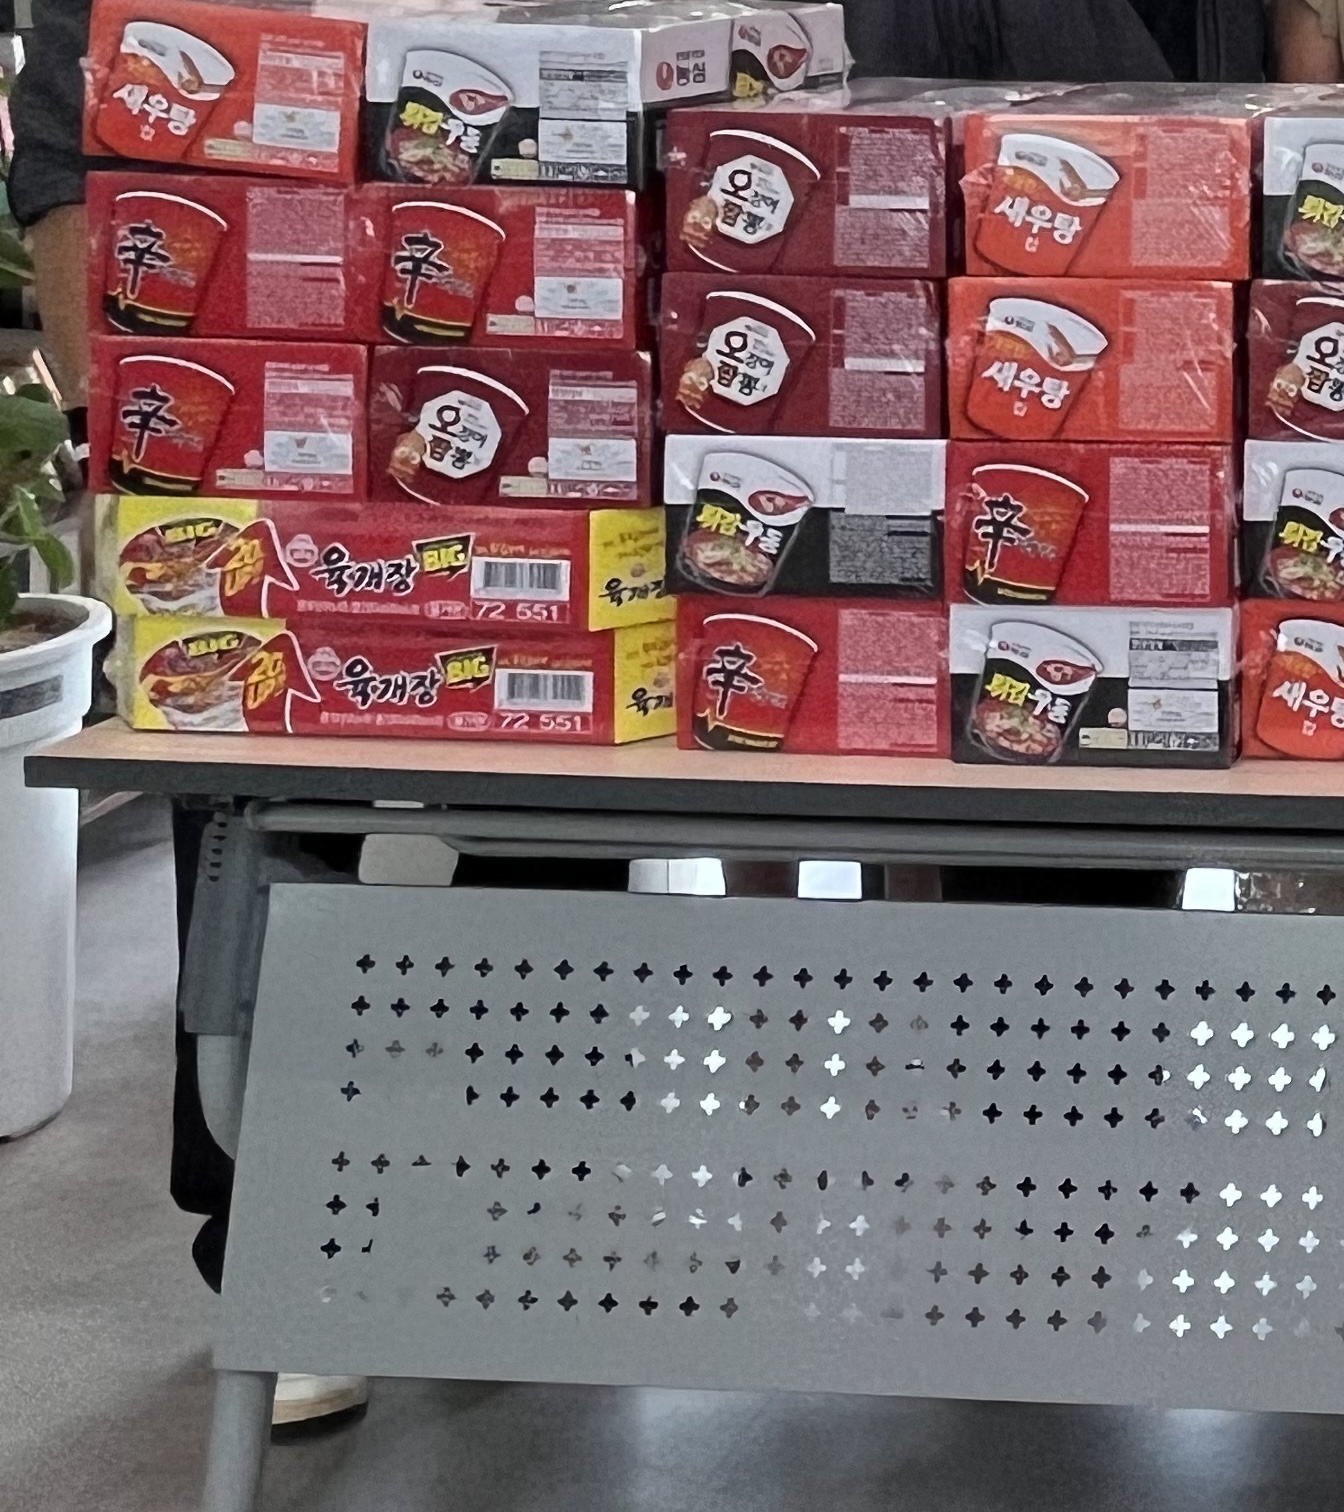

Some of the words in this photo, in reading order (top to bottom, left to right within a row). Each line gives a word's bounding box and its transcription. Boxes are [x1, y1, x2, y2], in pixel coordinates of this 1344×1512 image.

[994, 197, 1082, 245] 새우탕
[116, 219, 171, 299] 辛
[391, 230, 453, 308] 辛
[982, 361, 1070, 409] 새우탕
[120, 383, 181, 463] 辛
[972, 493, 1035, 573] 辛
[309, 542, 420, 598] 육개장
[333, 655, 443, 710] 육개장
[446, 656, 490, 681] BIG
[702, 642, 765, 720] 辛
[501, 712, 530, 730] 72
[539, 713, 582, 732] 551
